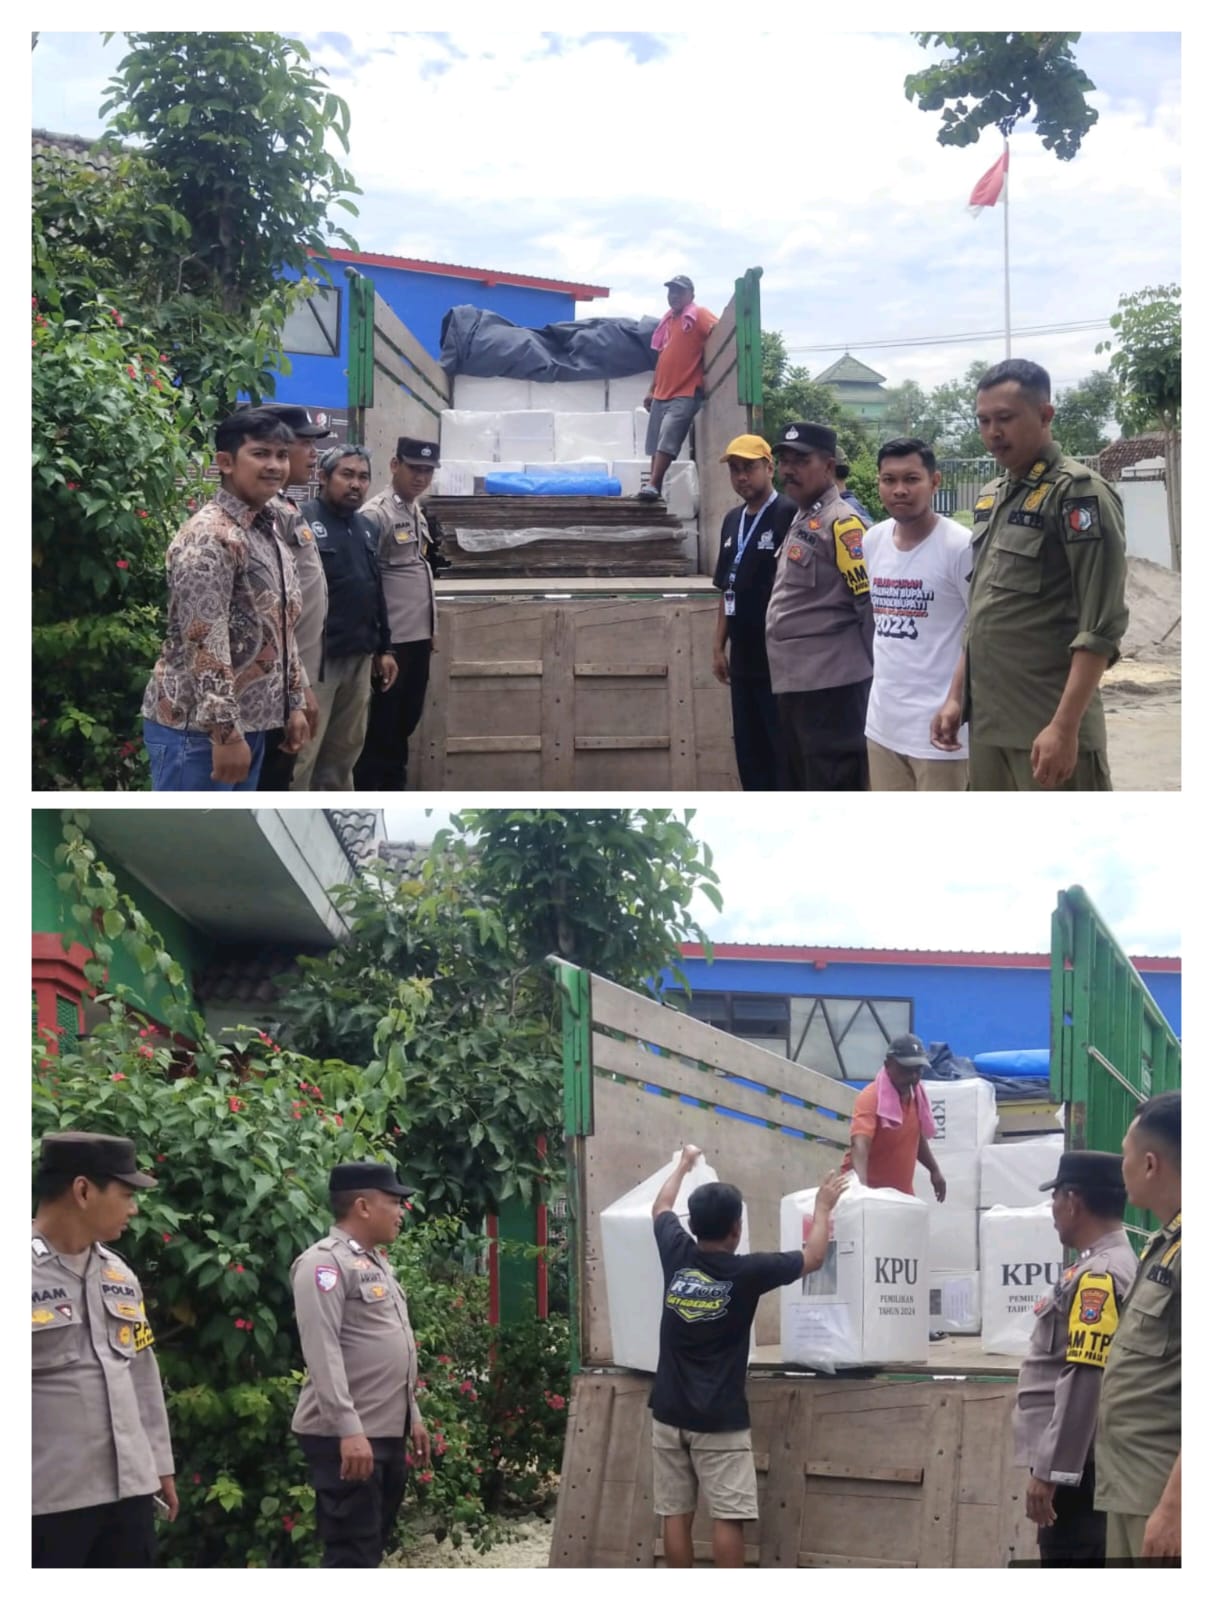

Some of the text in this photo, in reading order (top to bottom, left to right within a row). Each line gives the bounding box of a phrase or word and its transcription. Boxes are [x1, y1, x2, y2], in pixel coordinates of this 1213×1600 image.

[876, 615, 919, 640] 2024
[875, 1257, 919, 1285] KPU
[1001, 1262, 1063, 1286] KPU
[102, 1284, 136, 1297] POLRI
[879, 1307, 915, 1316] TAHUN 2024
